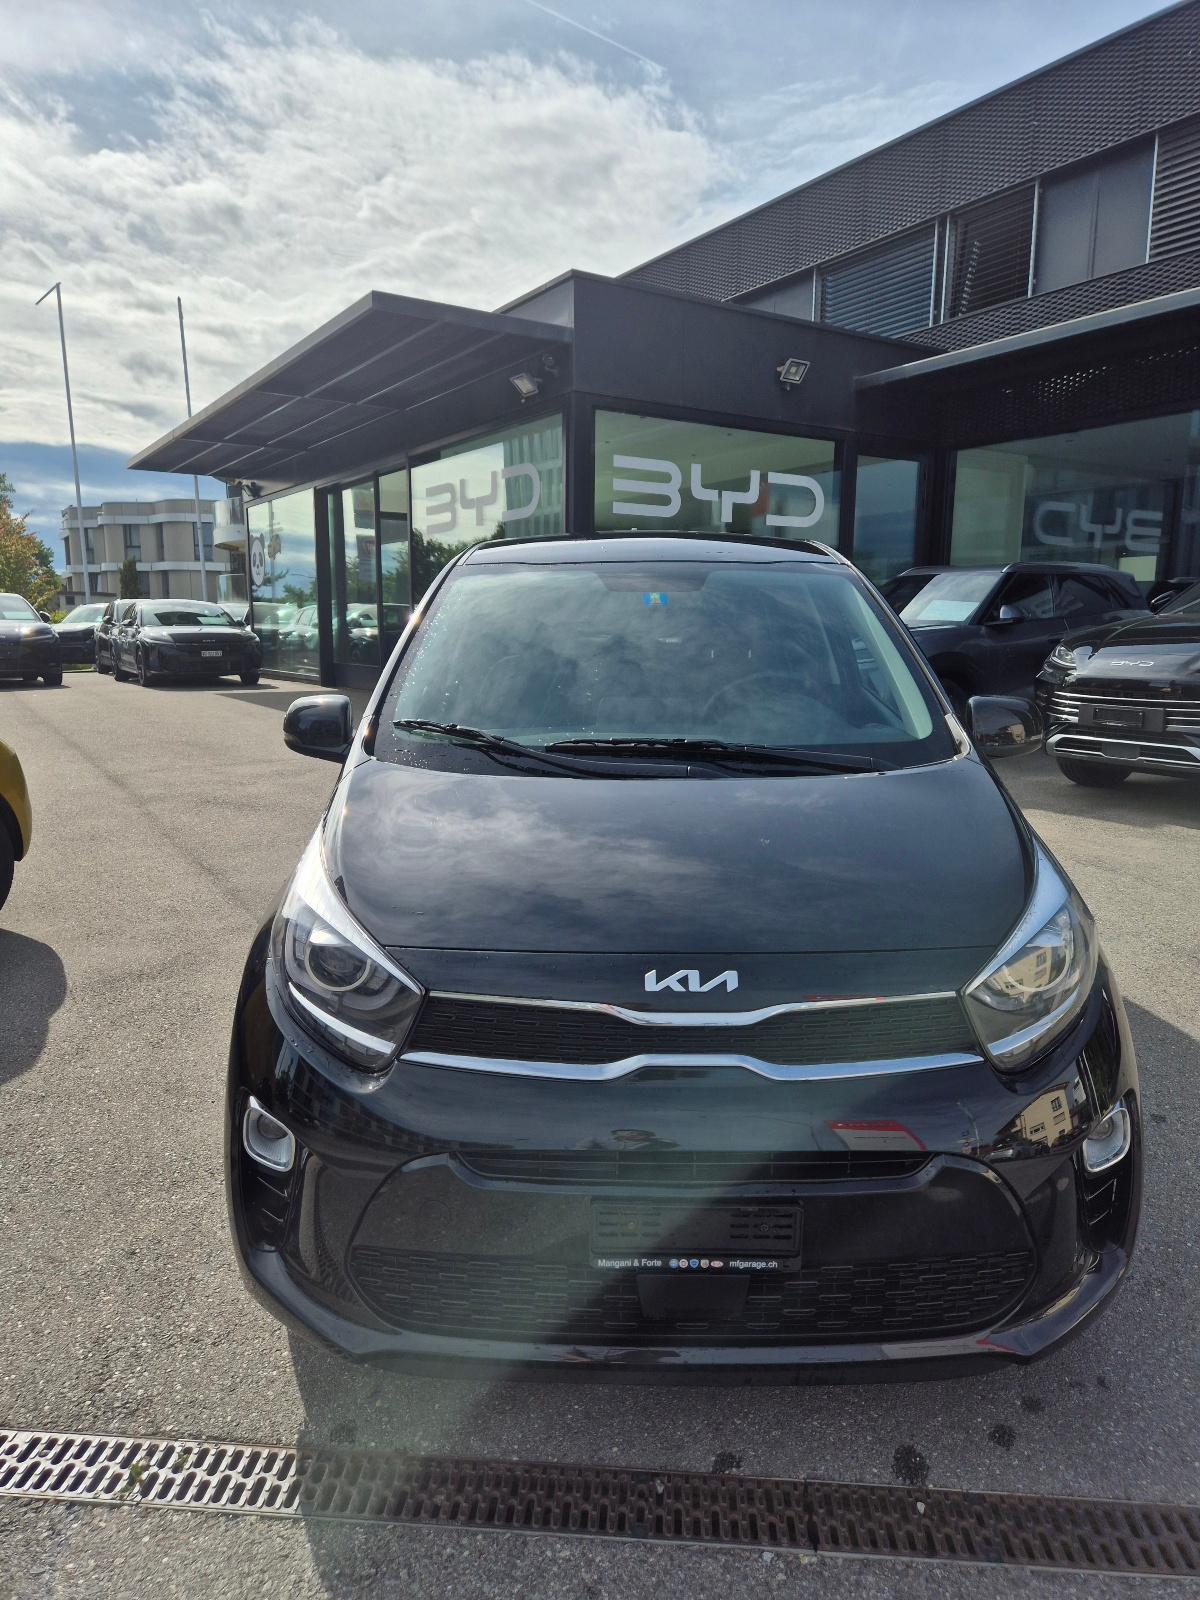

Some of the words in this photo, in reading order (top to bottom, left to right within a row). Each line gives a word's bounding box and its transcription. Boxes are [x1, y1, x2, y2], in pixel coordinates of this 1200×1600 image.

[425, 462, 541, 536] BYD
[612, 454, 825, 528] BYD
[644, 969, 739, 993] KIA
[597, 1258, 632, 1269] Mangani
[633, 1258, 640, 1267] &
[641, 1258, 662, 1267] Forte
[729, 1259, 778, 1270] mfgarage.ch
